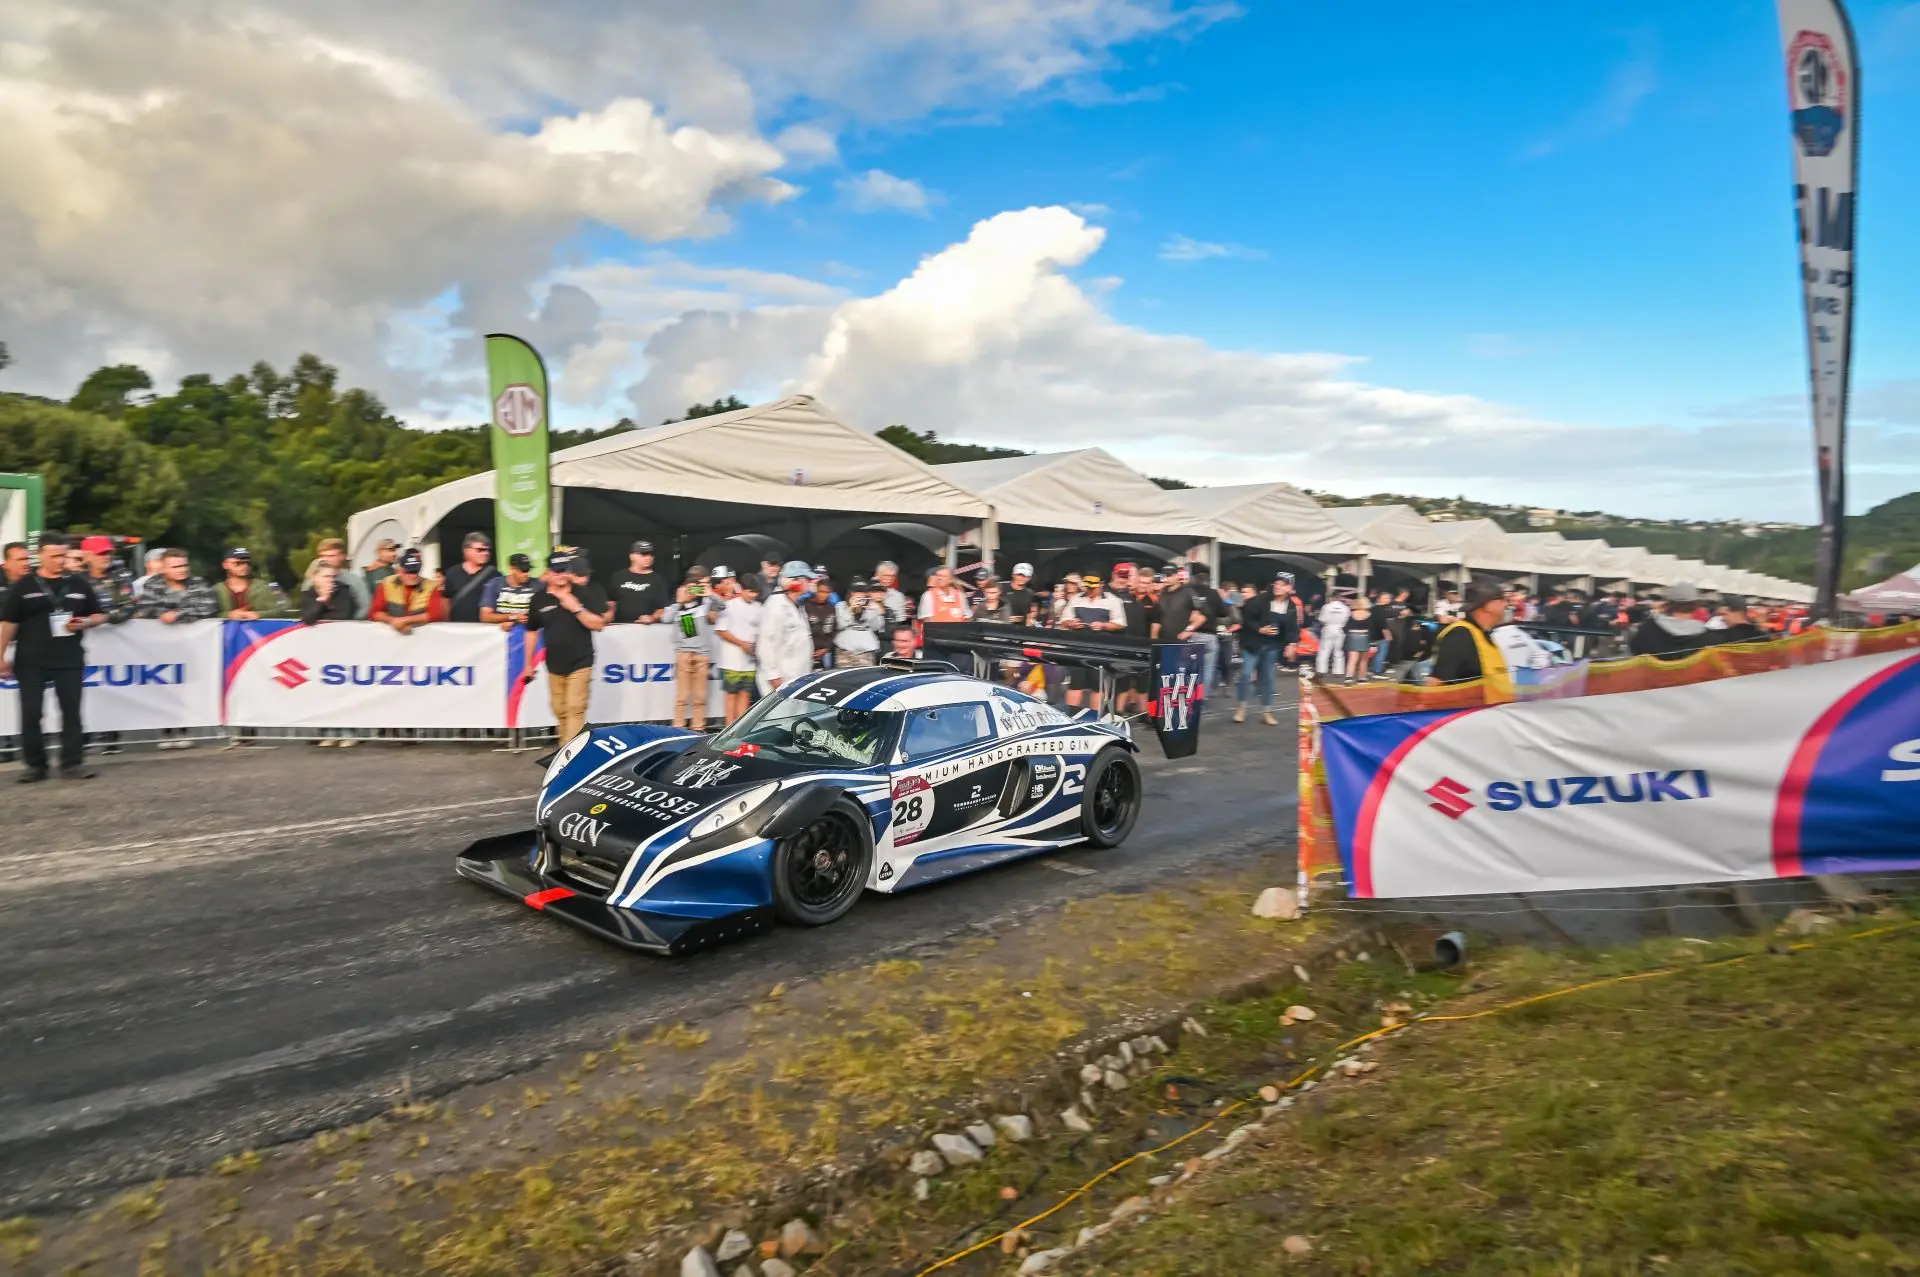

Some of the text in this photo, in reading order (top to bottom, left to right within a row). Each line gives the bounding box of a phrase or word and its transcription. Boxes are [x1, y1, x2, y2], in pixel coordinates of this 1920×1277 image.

[321, 664, 475, 686] SUZUKI
[924, 740, 1090, 781] MIUM HANDCRAFTED GIN
[626, 785, 699, 815] ROSE
[1486, 769, 1711, 811] SUZUKI
[603, 793, 673, 821] HANDCRAFTED
[893, 796, 923, 828] 28
[558, 812, 611, 847] GIN
